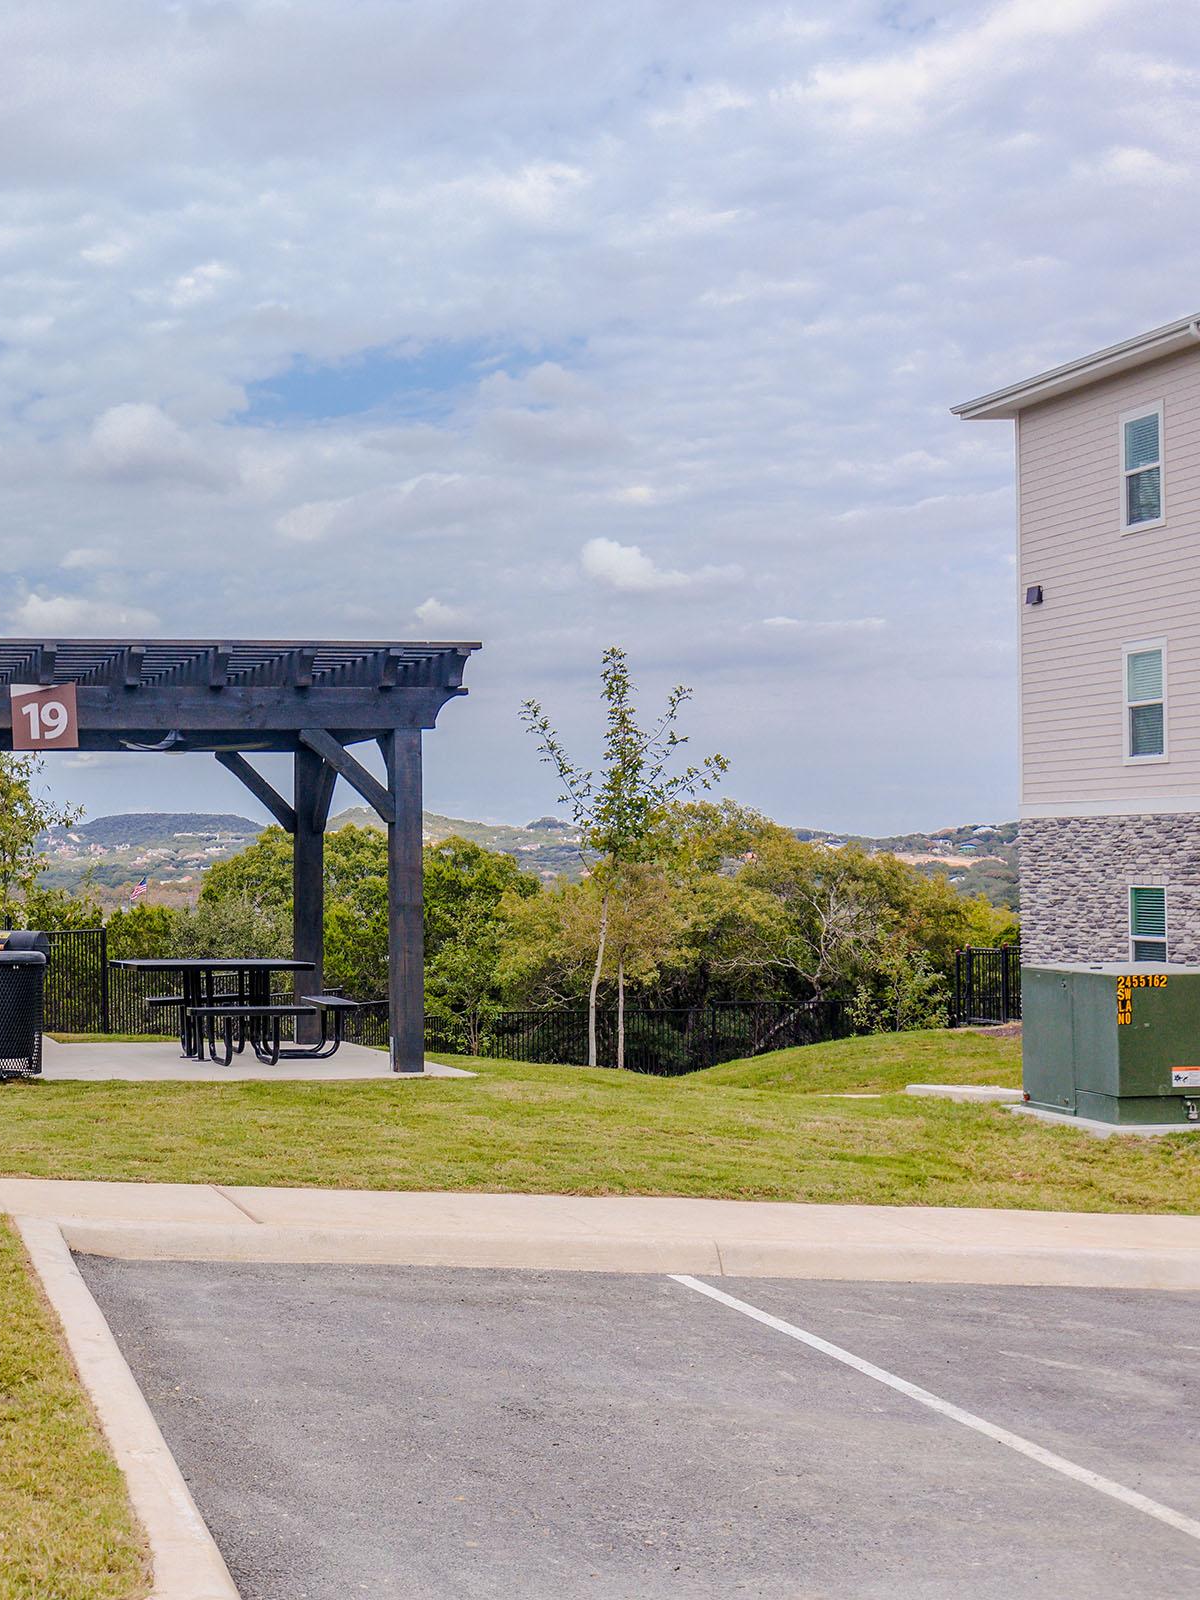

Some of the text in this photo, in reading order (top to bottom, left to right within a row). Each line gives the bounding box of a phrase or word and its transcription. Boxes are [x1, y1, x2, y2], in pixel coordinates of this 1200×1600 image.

[21, 701, 68, 740] 19
[1117, 975, 1168, 988] 2455162
[1117, 988, 1132, 1000] SW
[1118, 1001, 1132, 1012] LA
